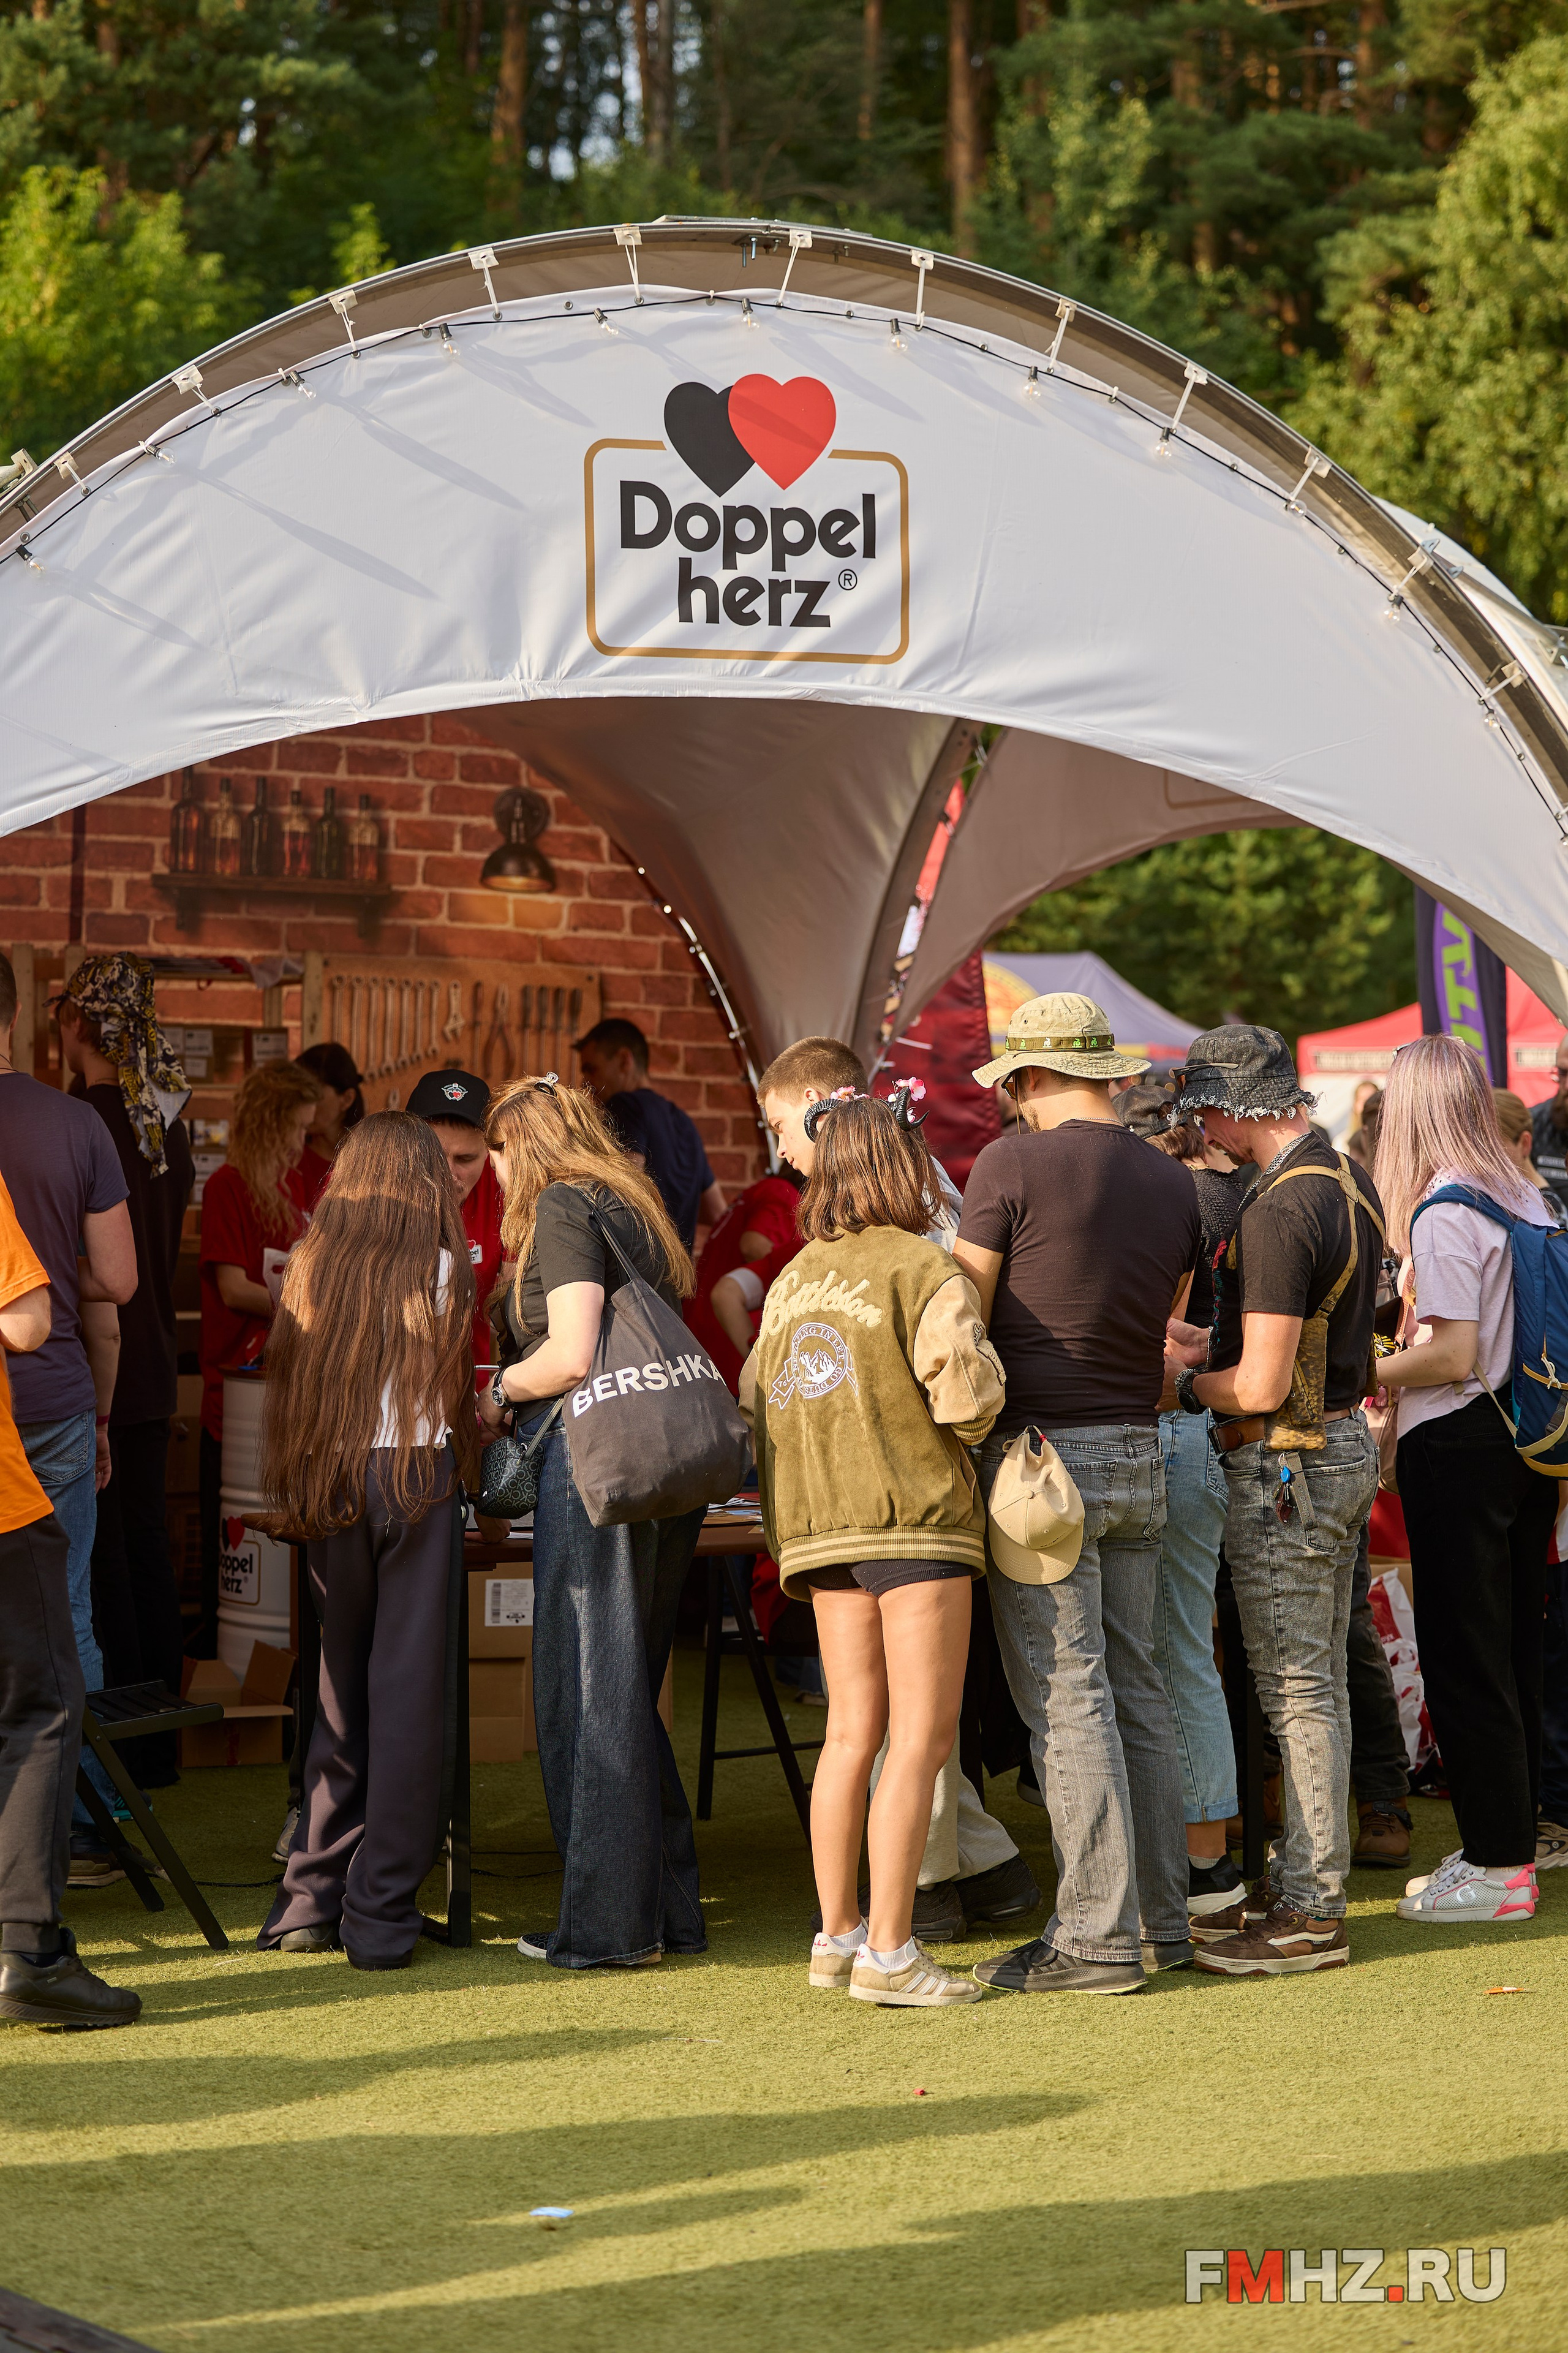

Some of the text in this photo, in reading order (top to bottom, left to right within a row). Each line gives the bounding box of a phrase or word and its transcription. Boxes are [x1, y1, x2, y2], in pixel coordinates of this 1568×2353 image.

[620, 480, 876, 572] Doppel
[572, 1354, 727, 1418] BERSHKA
[221, 1554, 252, 1576] oppel
